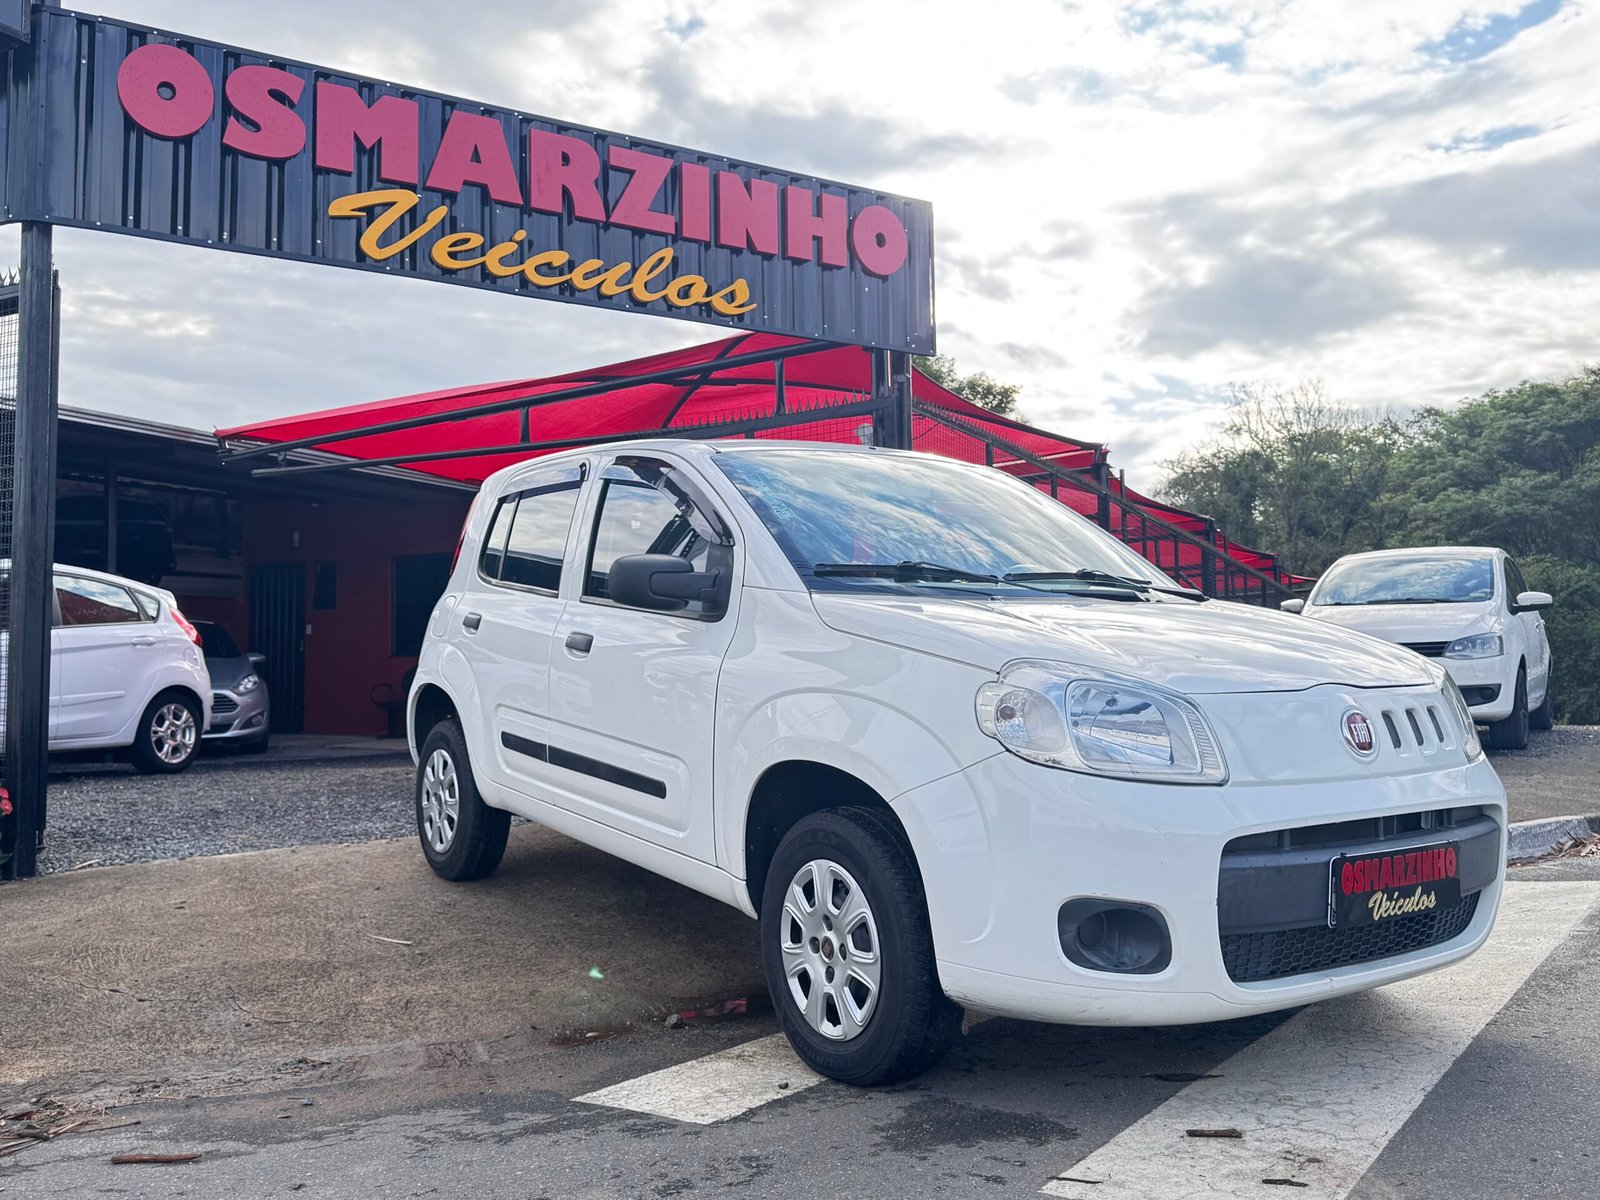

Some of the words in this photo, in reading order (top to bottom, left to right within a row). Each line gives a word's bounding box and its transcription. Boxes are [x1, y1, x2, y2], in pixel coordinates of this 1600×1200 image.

[117, 44, 908, 276] OSMARZINHO
[328, 189, 758, 315] Veiculos
[1350, 723, 1371, 743] FIAT
[1341, 847, 1457, 896] OSMARZINHO
